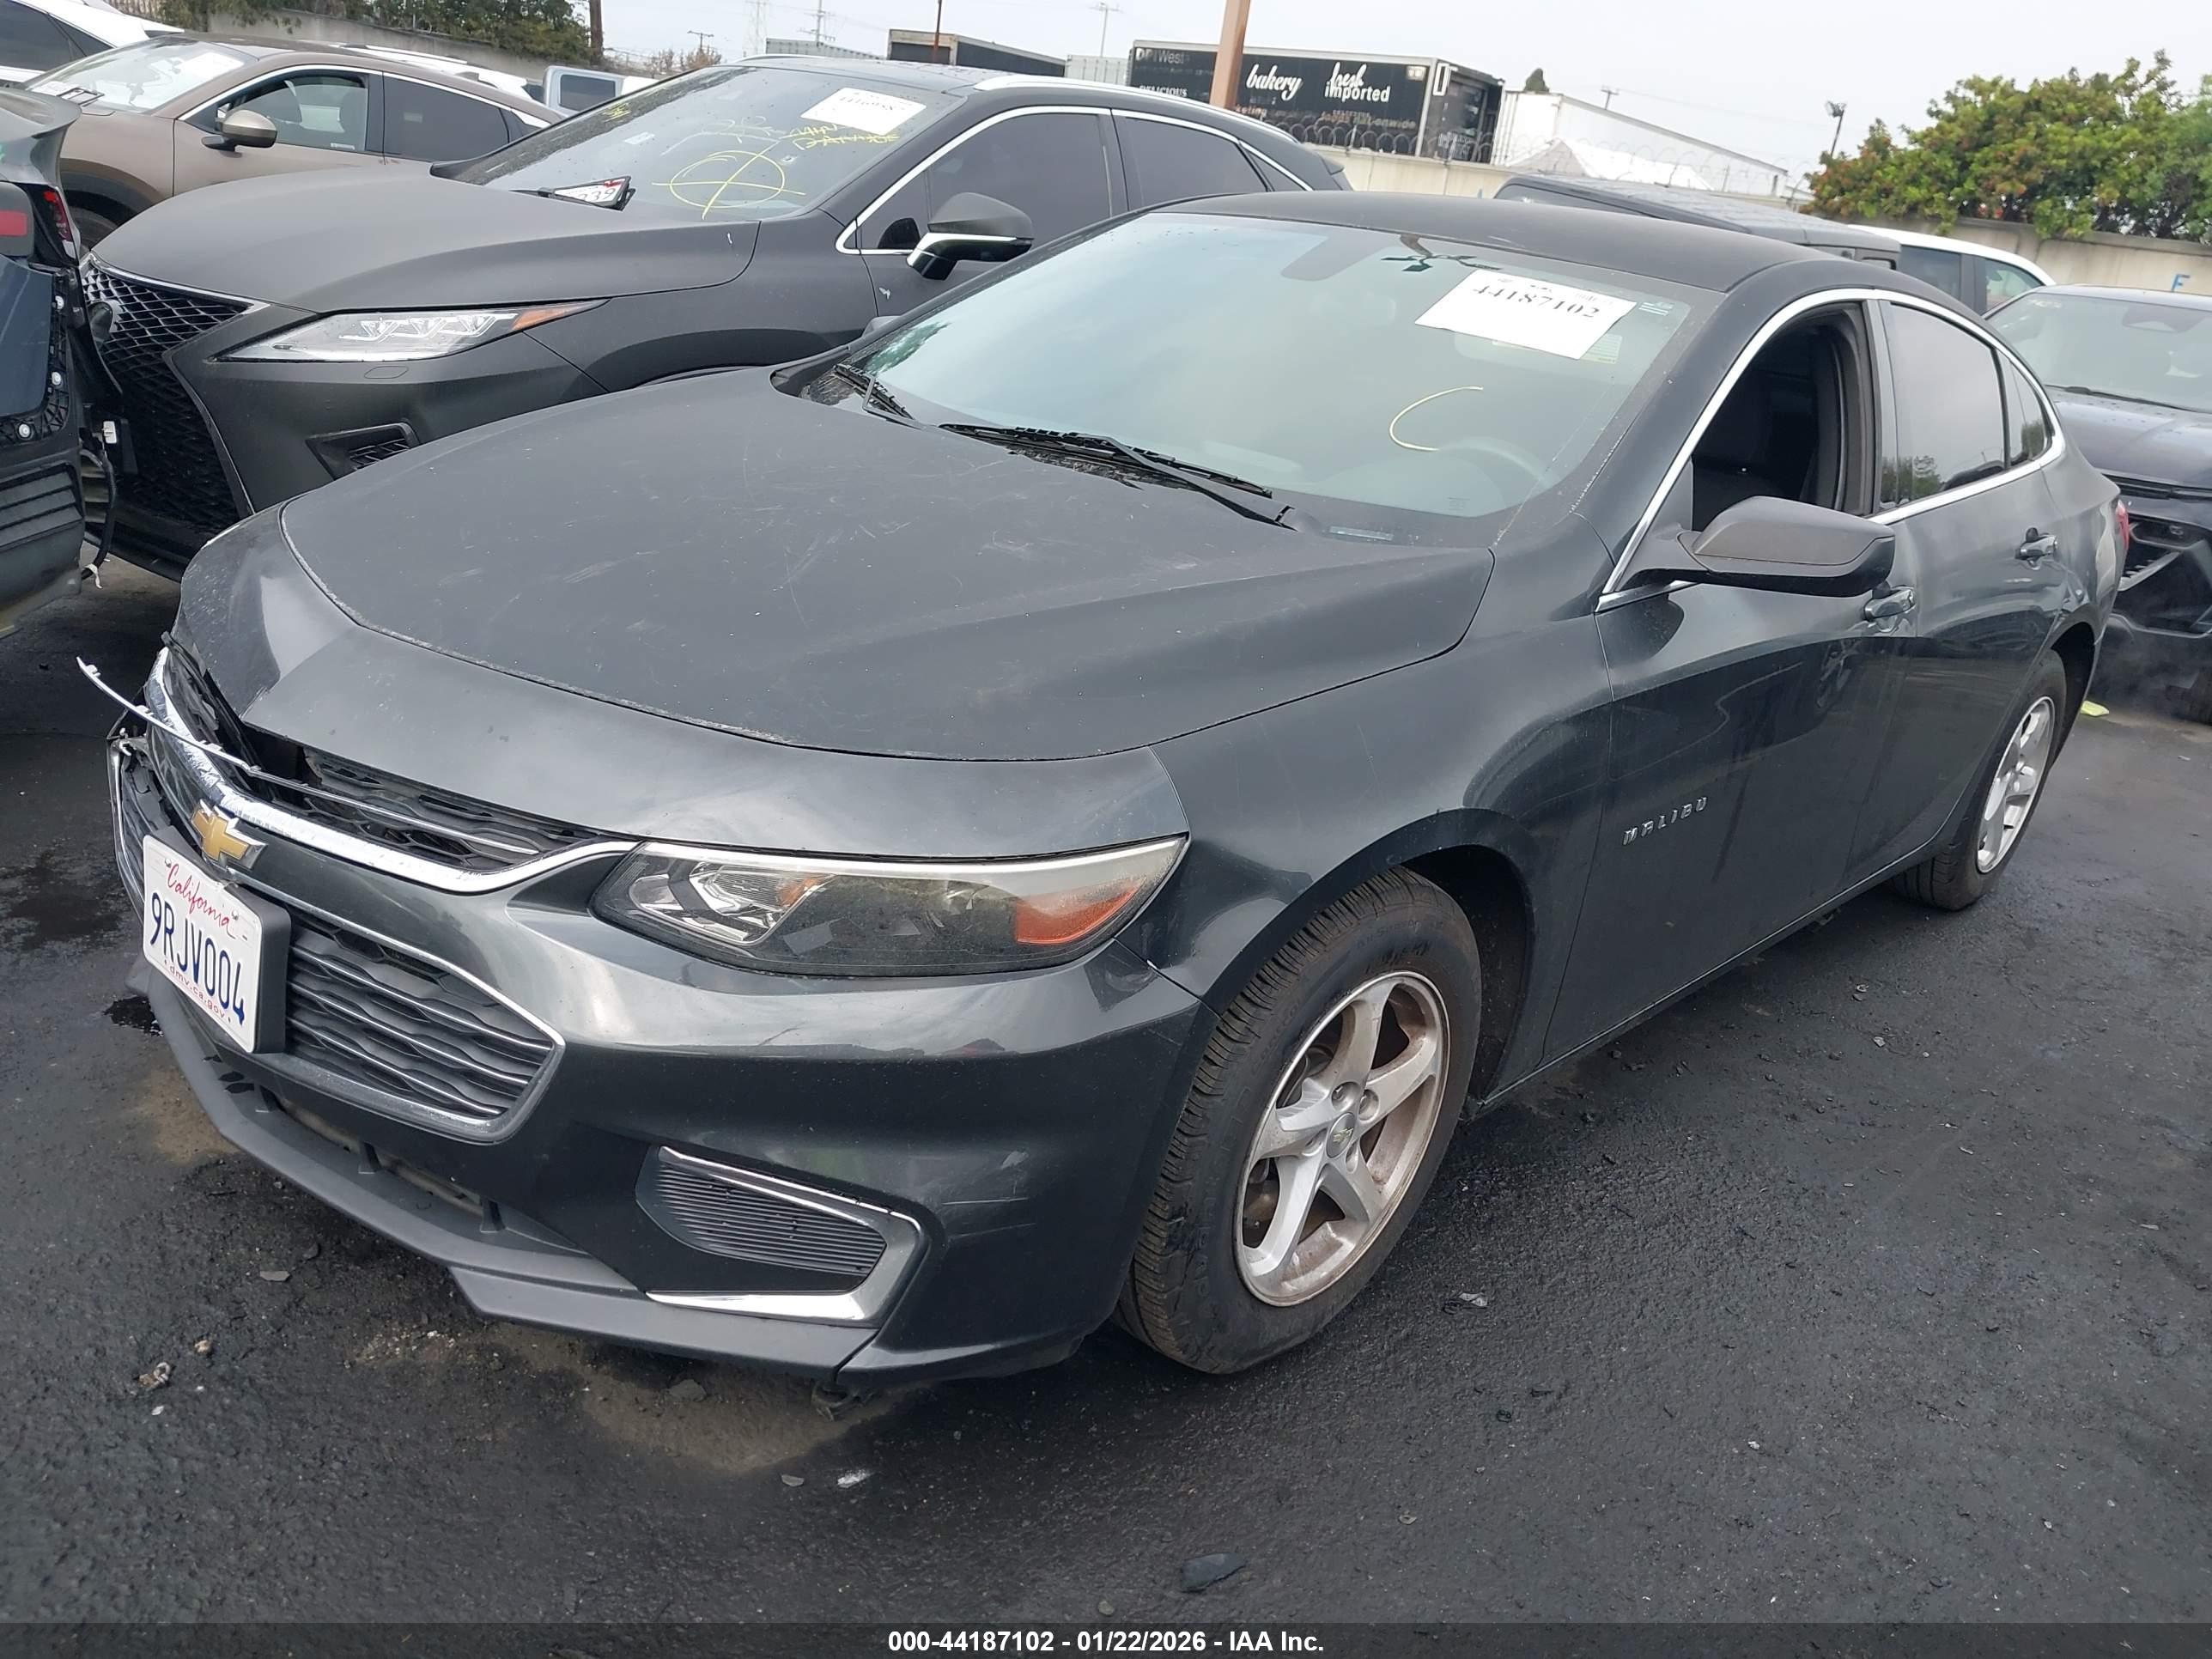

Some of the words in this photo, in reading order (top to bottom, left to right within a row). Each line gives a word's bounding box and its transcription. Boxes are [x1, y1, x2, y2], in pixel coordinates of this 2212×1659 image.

[1158, 49, 1185, 64] West
[1246, 63, 1303, 101] bakery
[1324, 81, 1391, 103] imported
[1473, 285, 1600, 319] 44187102
[1622, 796, 1708, 846] MALIBU
[167, 863, 236, 940] California
[149, 891, 246, 1026] 9RJV004
[169, 964, 226, 1019] dmv.ca.gov
